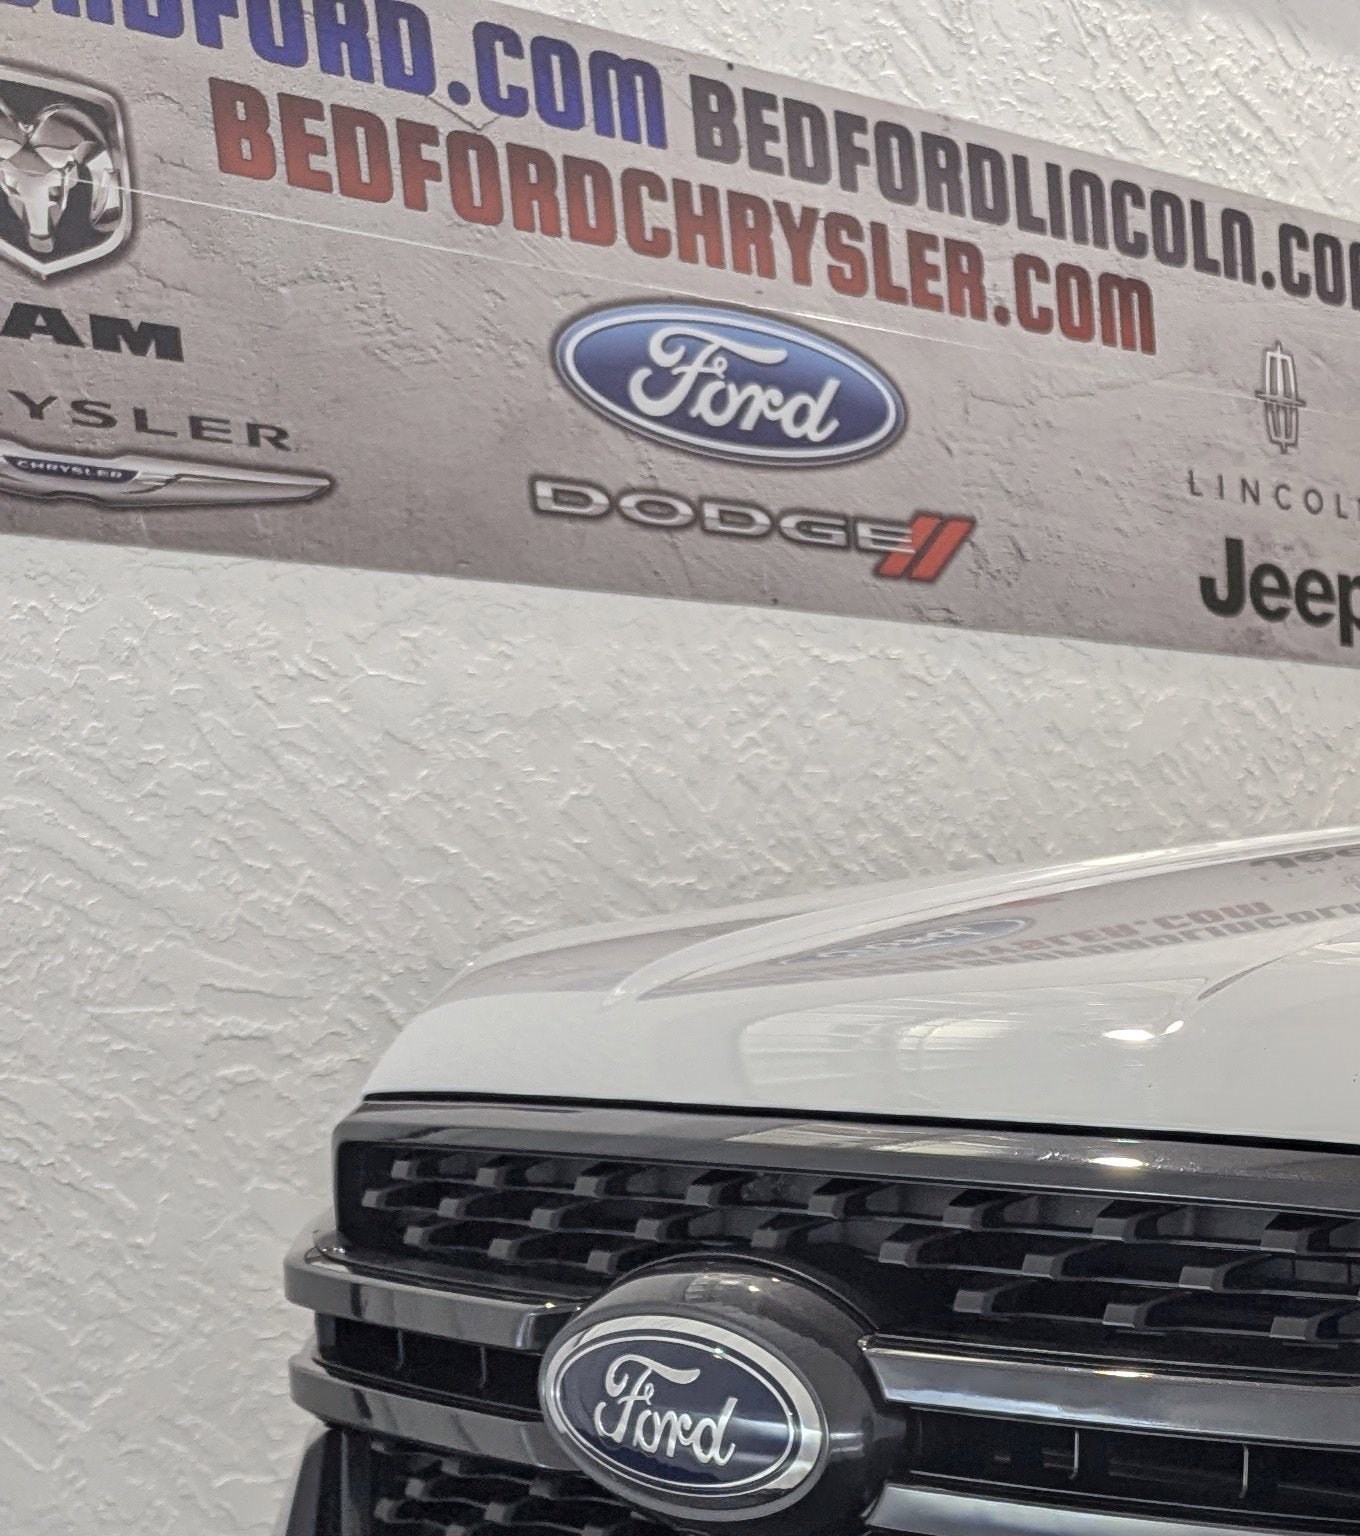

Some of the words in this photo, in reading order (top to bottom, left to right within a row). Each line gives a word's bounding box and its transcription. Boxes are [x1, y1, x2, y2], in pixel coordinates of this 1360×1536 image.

[209, 77, 1156, 355] BEDFORDCHRYSLER.COM
[630, 325, 840, 443] Ford
[17, 459, 123, 479] CHRYSLER
[533, 477, 916, 554] DODGE
[595, 1353, 738, 1467] Ford
